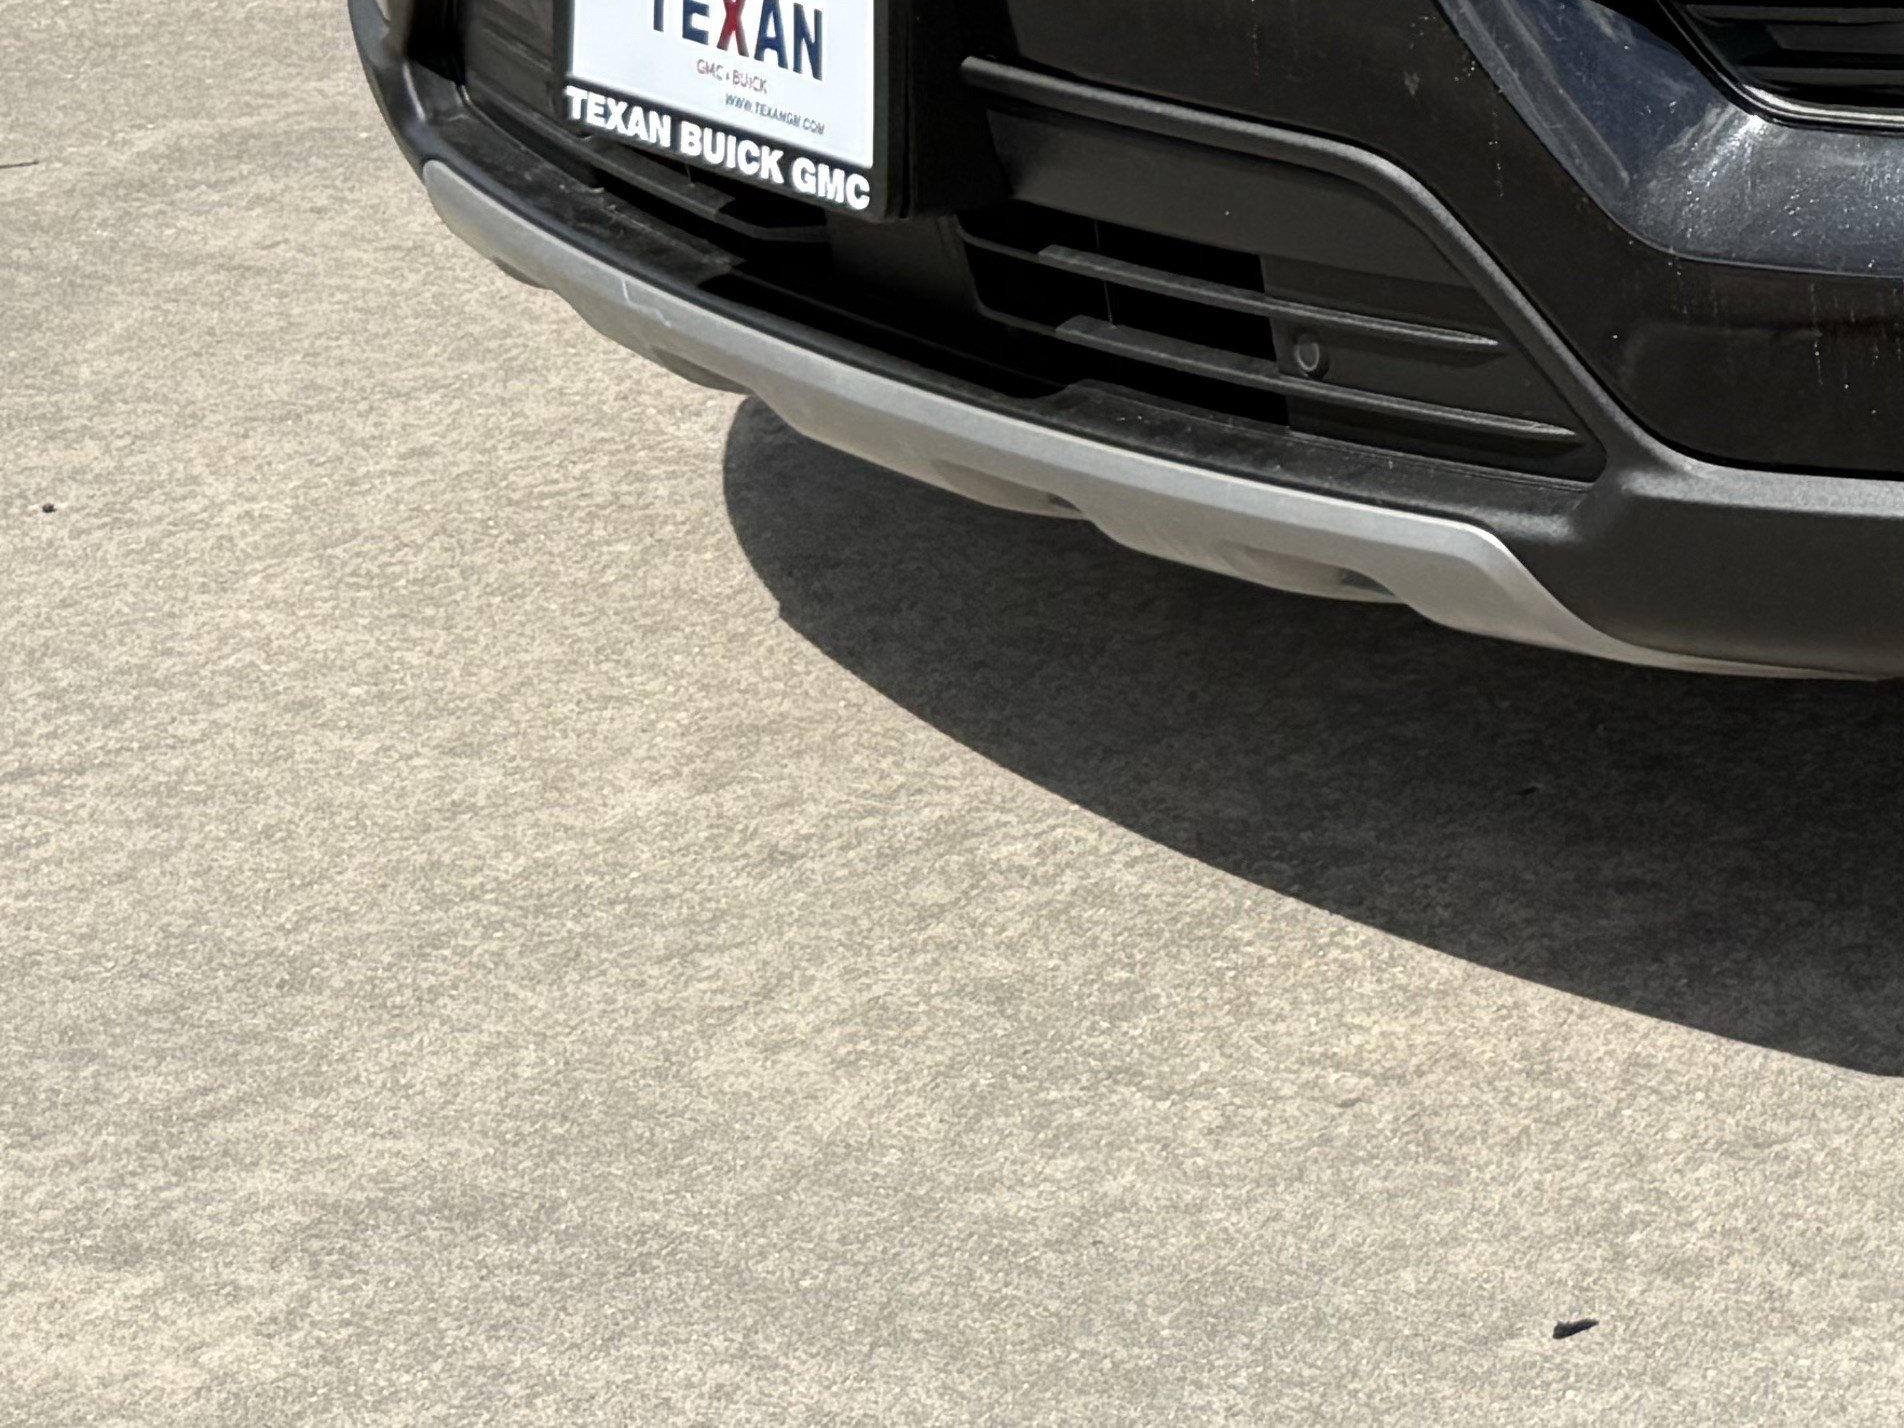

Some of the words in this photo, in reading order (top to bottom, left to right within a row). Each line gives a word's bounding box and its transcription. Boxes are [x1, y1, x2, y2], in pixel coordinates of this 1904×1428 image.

[696, 58, 723, 82] GMC
[732, 69, 768, 94] BUICK
[566, 85, 672, 150] TEXAN
[680, 120, 785, 185] BUICK
[791, 158, 871, 212] GMC
